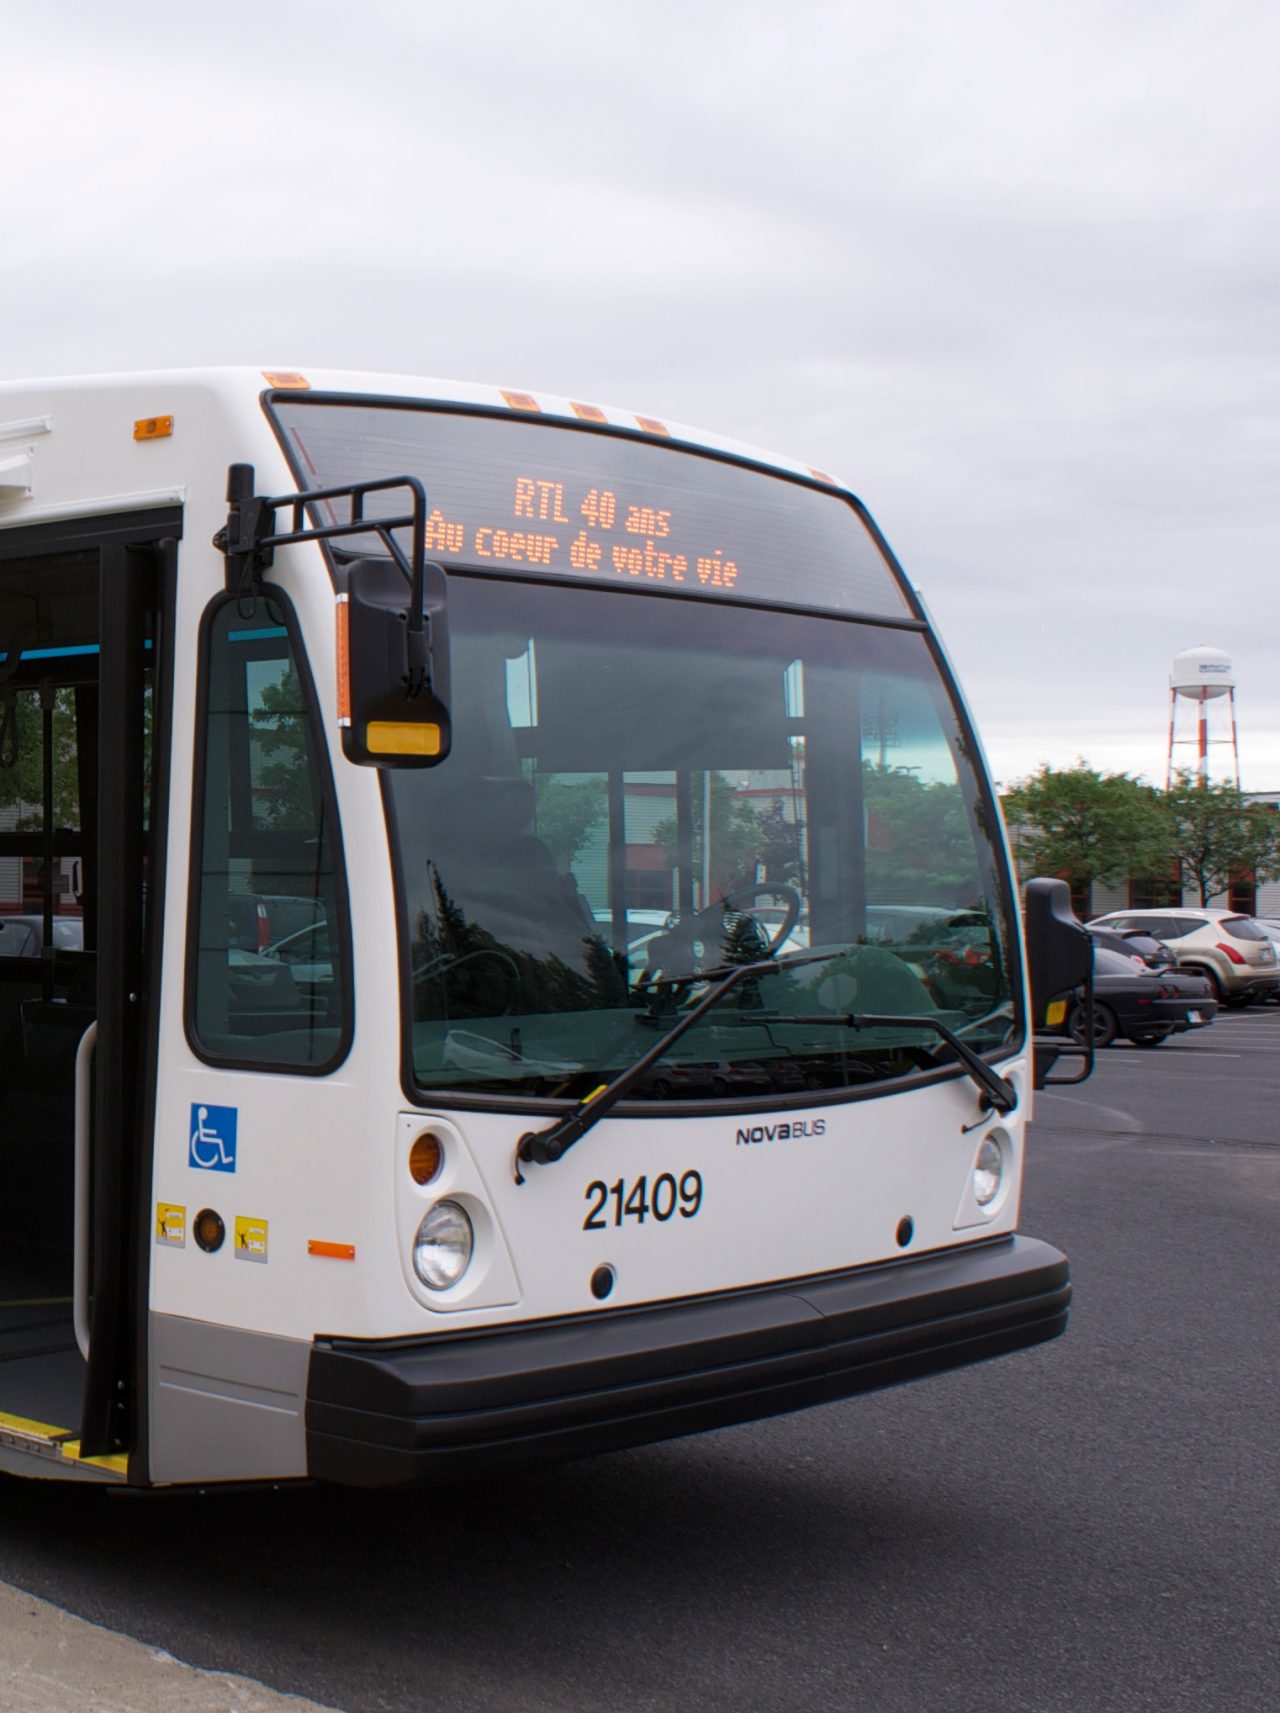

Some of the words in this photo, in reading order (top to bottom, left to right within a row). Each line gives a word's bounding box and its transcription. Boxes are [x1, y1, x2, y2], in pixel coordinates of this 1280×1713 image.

[515, 478, 568, 522] RTL
[581, 488, 616, 529] 40
[625, 506, 671, 537] ans
[425, 509, 464, 552] Au
[475, 527, 559, 564] coeur
[570, 530, 602, 570] de
[612, 540, 688, 581] votre
[697, 549, 738, 587] vie
[582, 1169, 703, 1230] 21409
